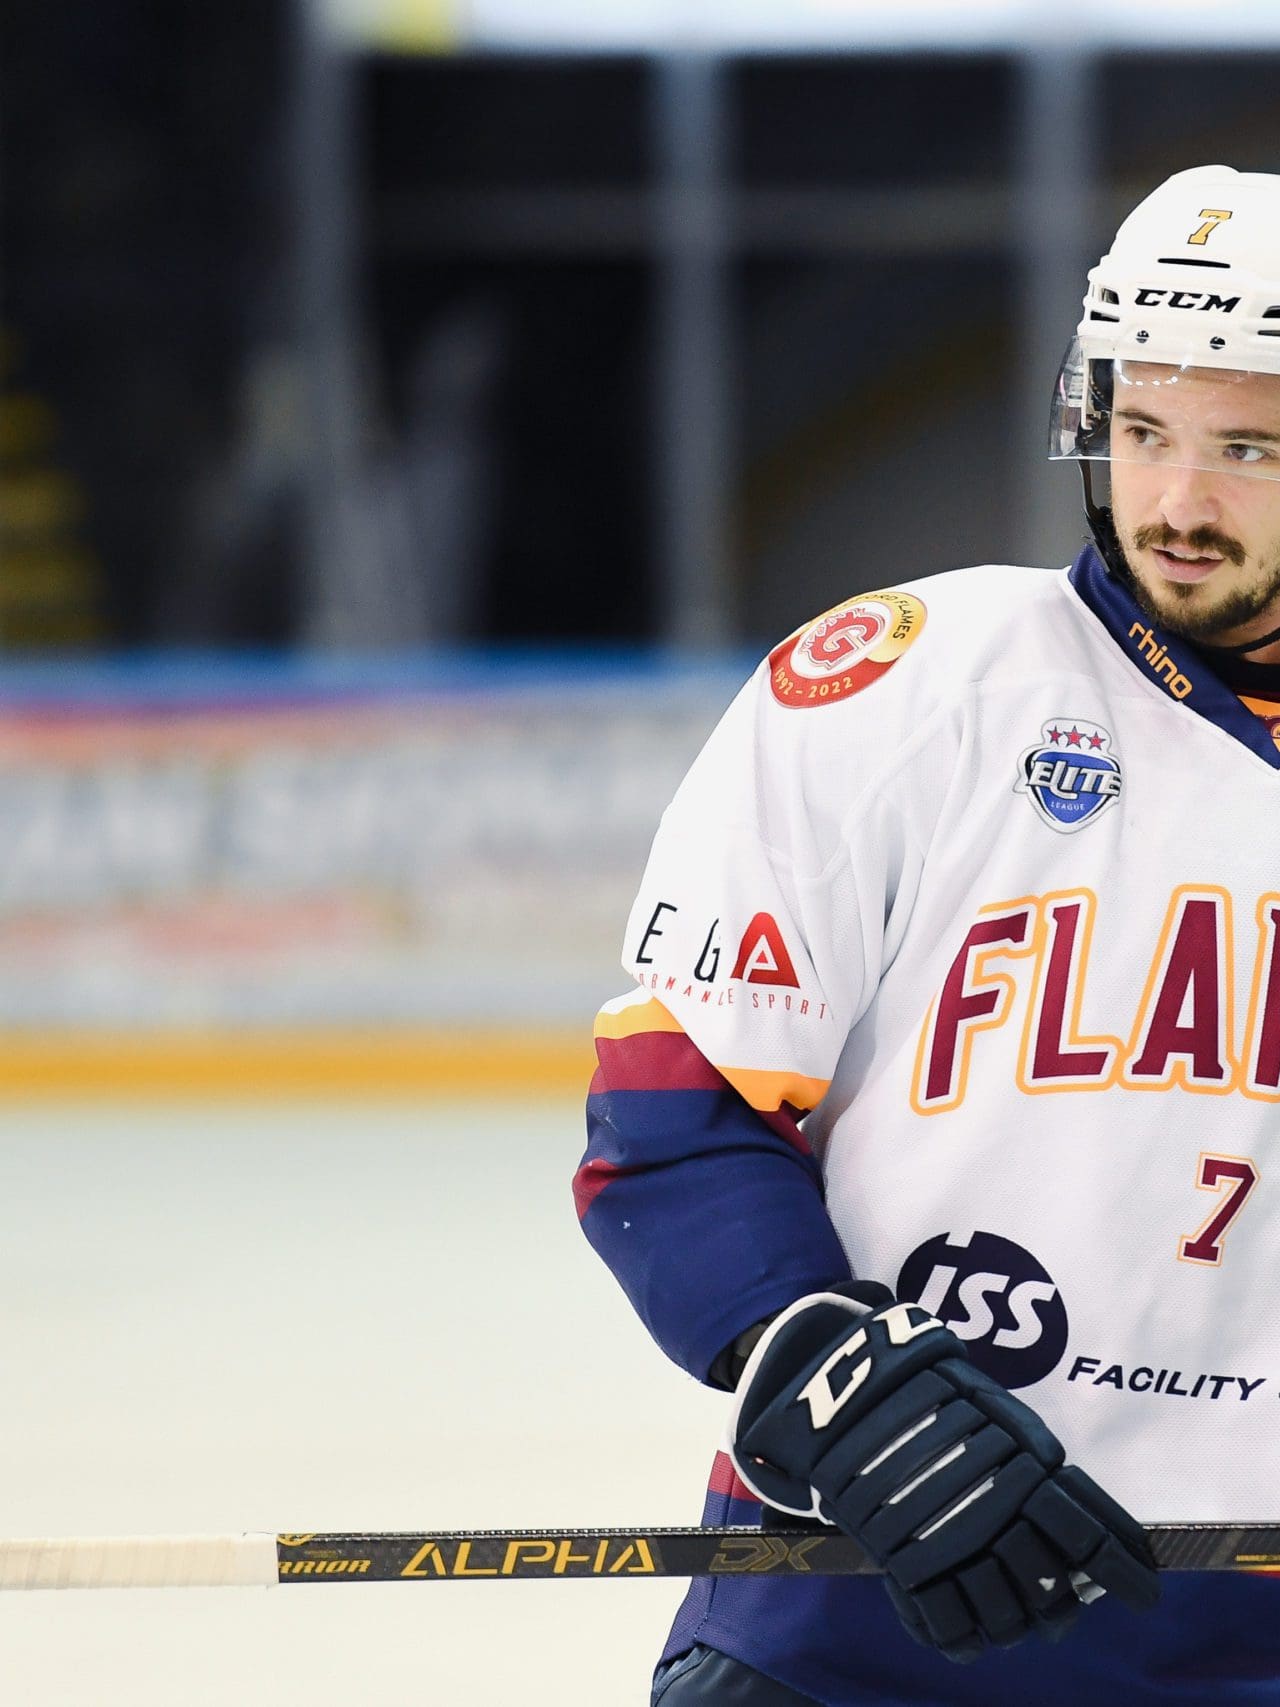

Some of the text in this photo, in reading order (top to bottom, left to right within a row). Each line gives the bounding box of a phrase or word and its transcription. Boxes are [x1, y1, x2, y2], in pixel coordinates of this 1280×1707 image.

[1187, 209, 1232, 245] 7
[1134, 288, 1241, 313] CCM
[893, 600, 914, 640] FLAMES
[1129, 622, 1193, 699] rhino
[774, 667, 794, 696] 1992
[808, 677, 853, 698] 2022
[1026, 760, 1122, 800] ELITE
[1050, 801, 1086, 811] LEAGUE
[752, 993, 826, 1020] SPORT
[1178, 1153, 1259, 1265] 7
[916, 1264, 1057, 1349] ISS
[1067, 1357, 1266, 1402] FACILITY
[402, 1537, 827, 1577] ALPHA DX
